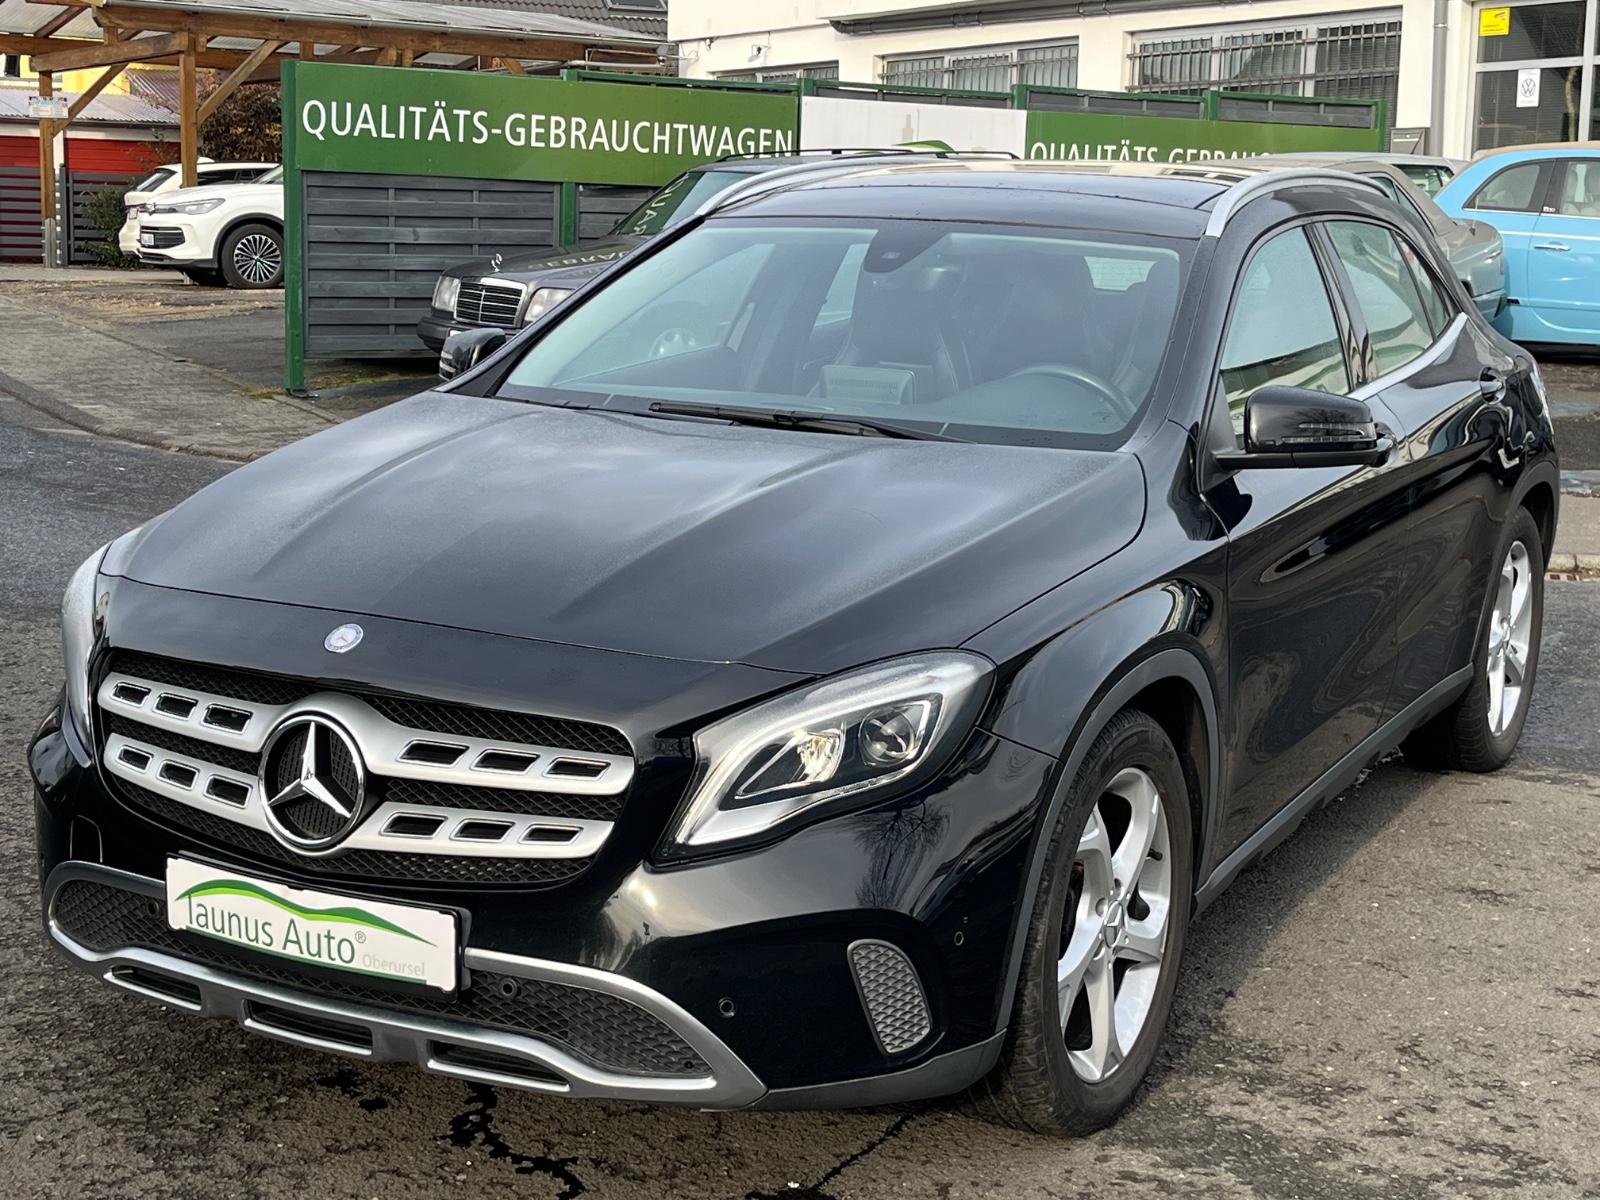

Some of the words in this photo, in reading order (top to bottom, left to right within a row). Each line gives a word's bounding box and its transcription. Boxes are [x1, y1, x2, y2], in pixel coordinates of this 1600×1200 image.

[302, 99, 793, 159] QUALITÄTS-GEBRAUCHTWAGEN
[186, 893, 274, 947] Taunus
[361, 953, 426, 978] Oberursel
